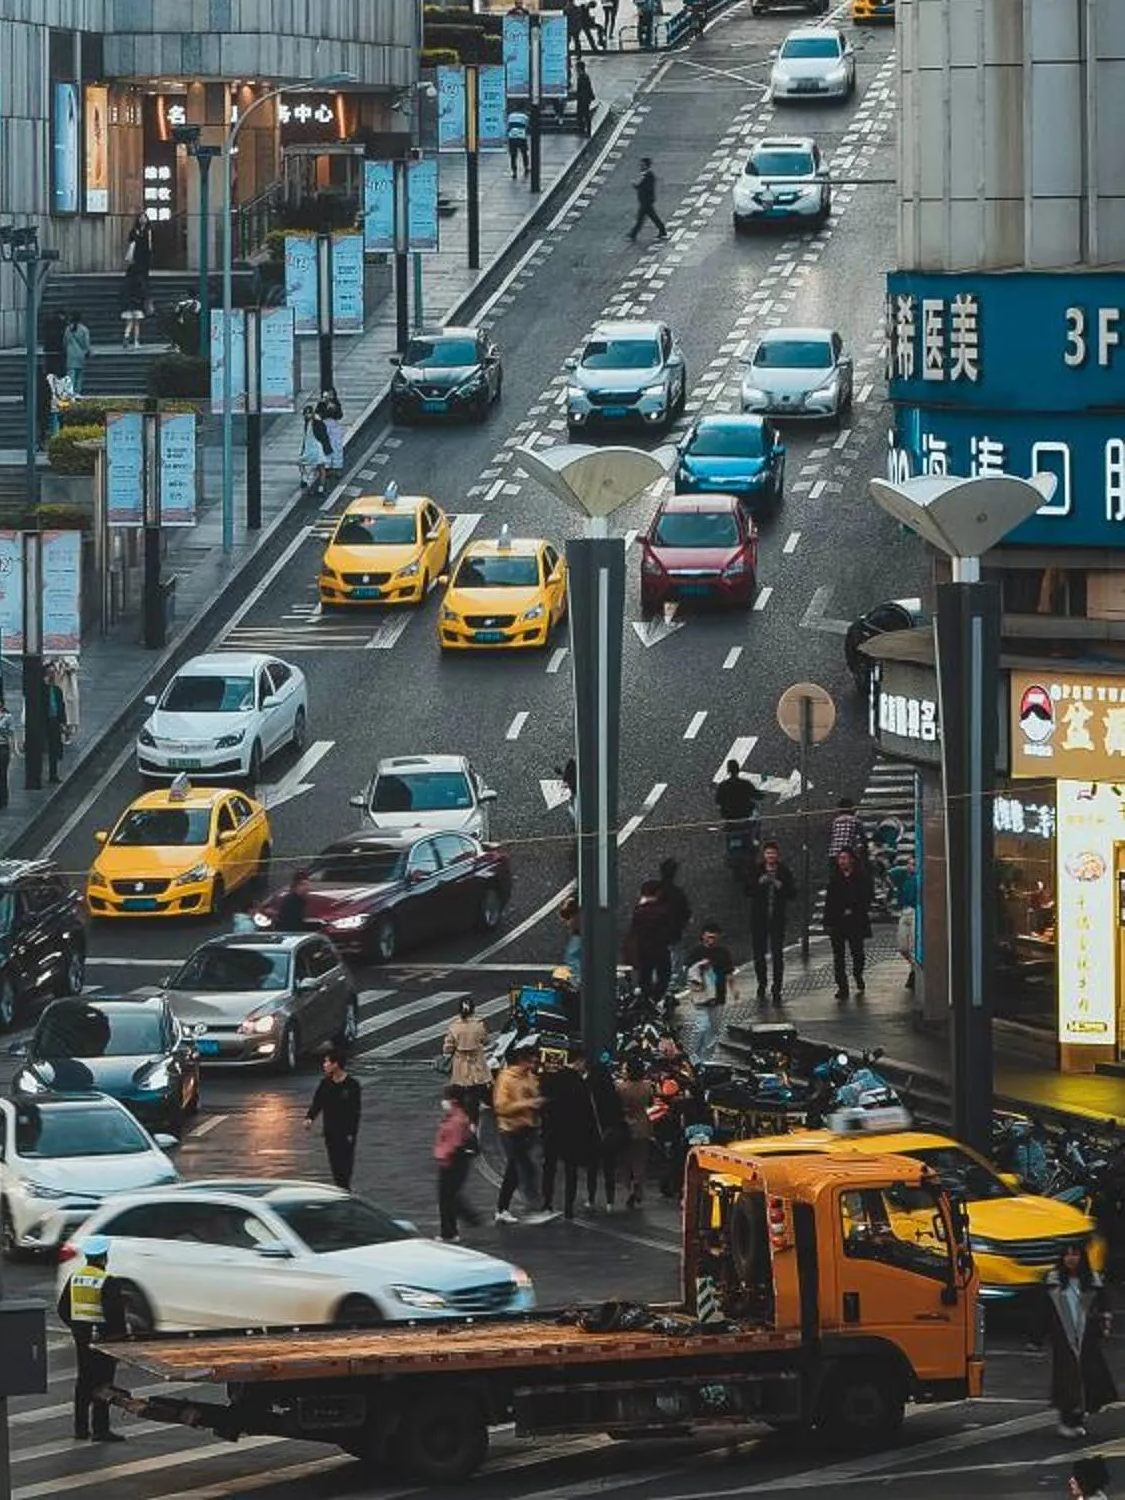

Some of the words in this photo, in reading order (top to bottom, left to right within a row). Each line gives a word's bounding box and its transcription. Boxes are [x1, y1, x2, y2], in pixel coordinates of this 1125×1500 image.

[887, 292, 978, 382] 希医美
[1064, 307, 1120, 366] 3F
